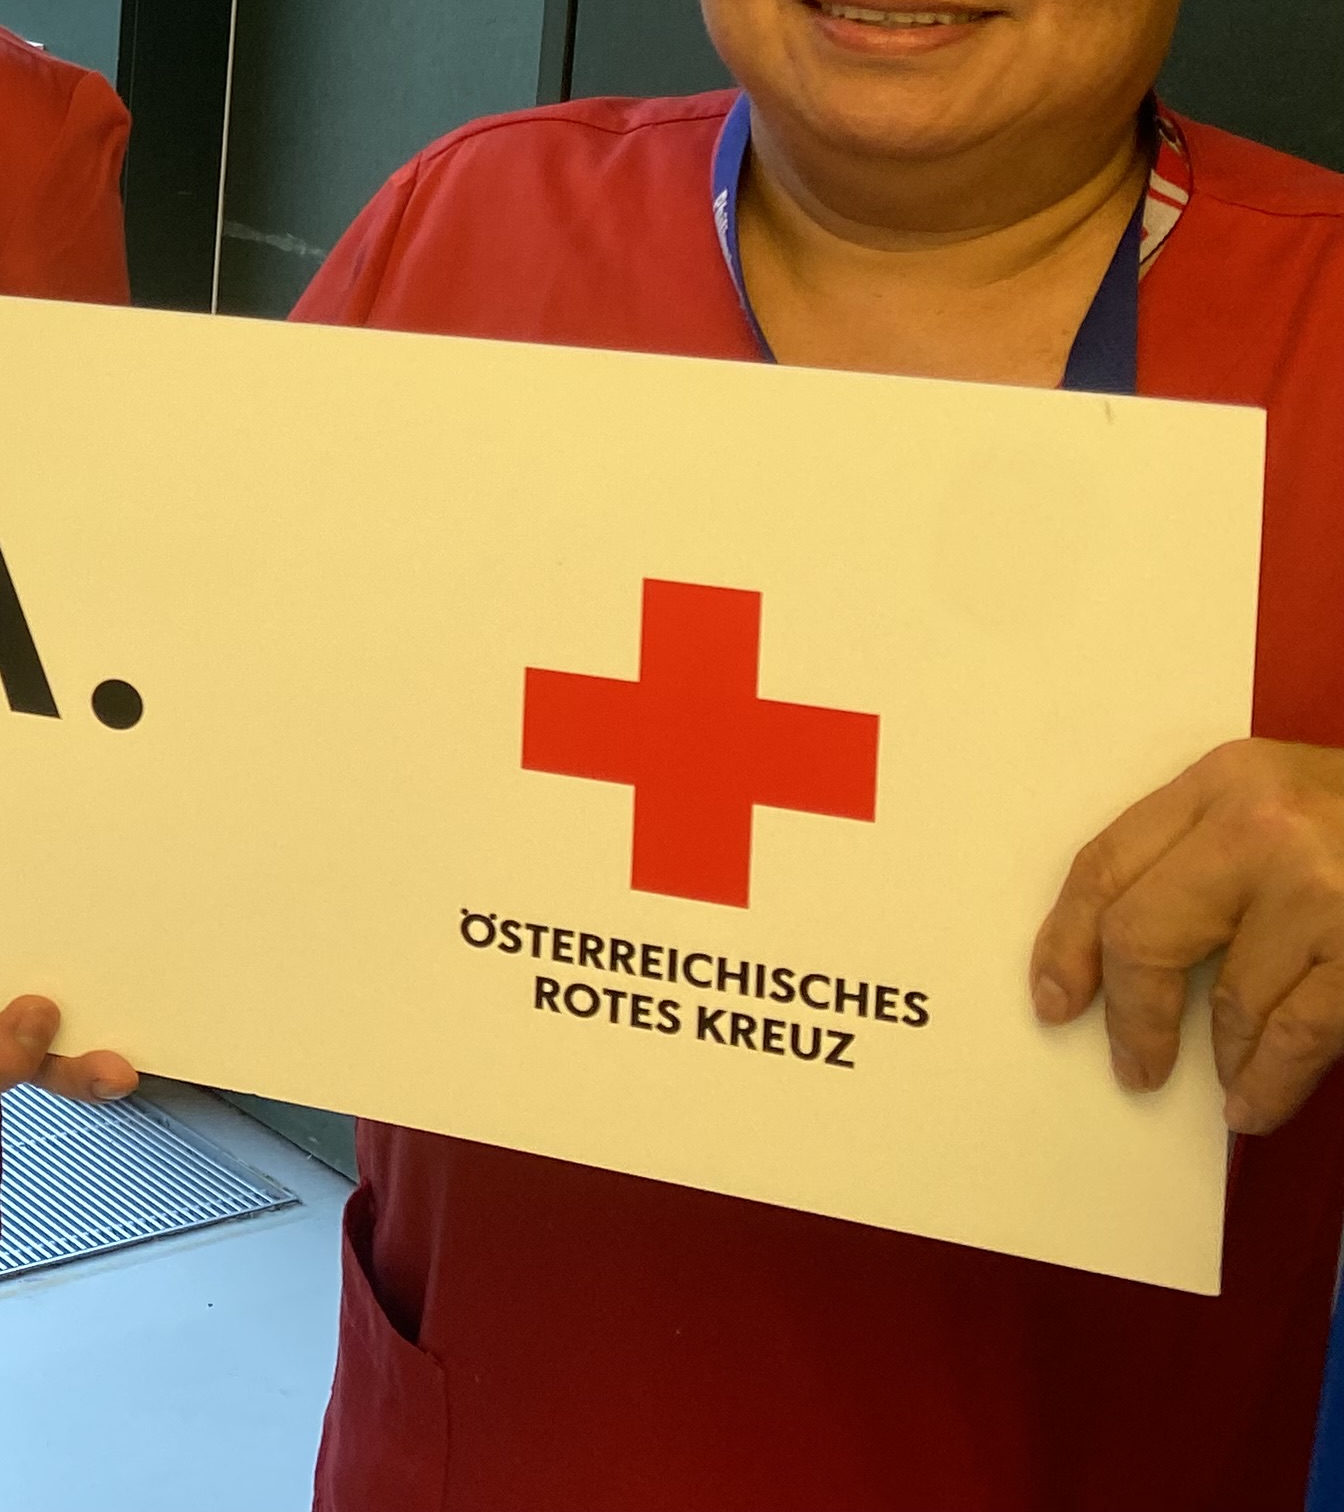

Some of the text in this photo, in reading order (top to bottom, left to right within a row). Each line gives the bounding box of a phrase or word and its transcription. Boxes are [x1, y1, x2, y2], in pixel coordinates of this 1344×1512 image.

[459, 908, 931, 1029] ÖSTERREICHISCHES
[533, 975, 856, 1070] ROTES KREUZ
